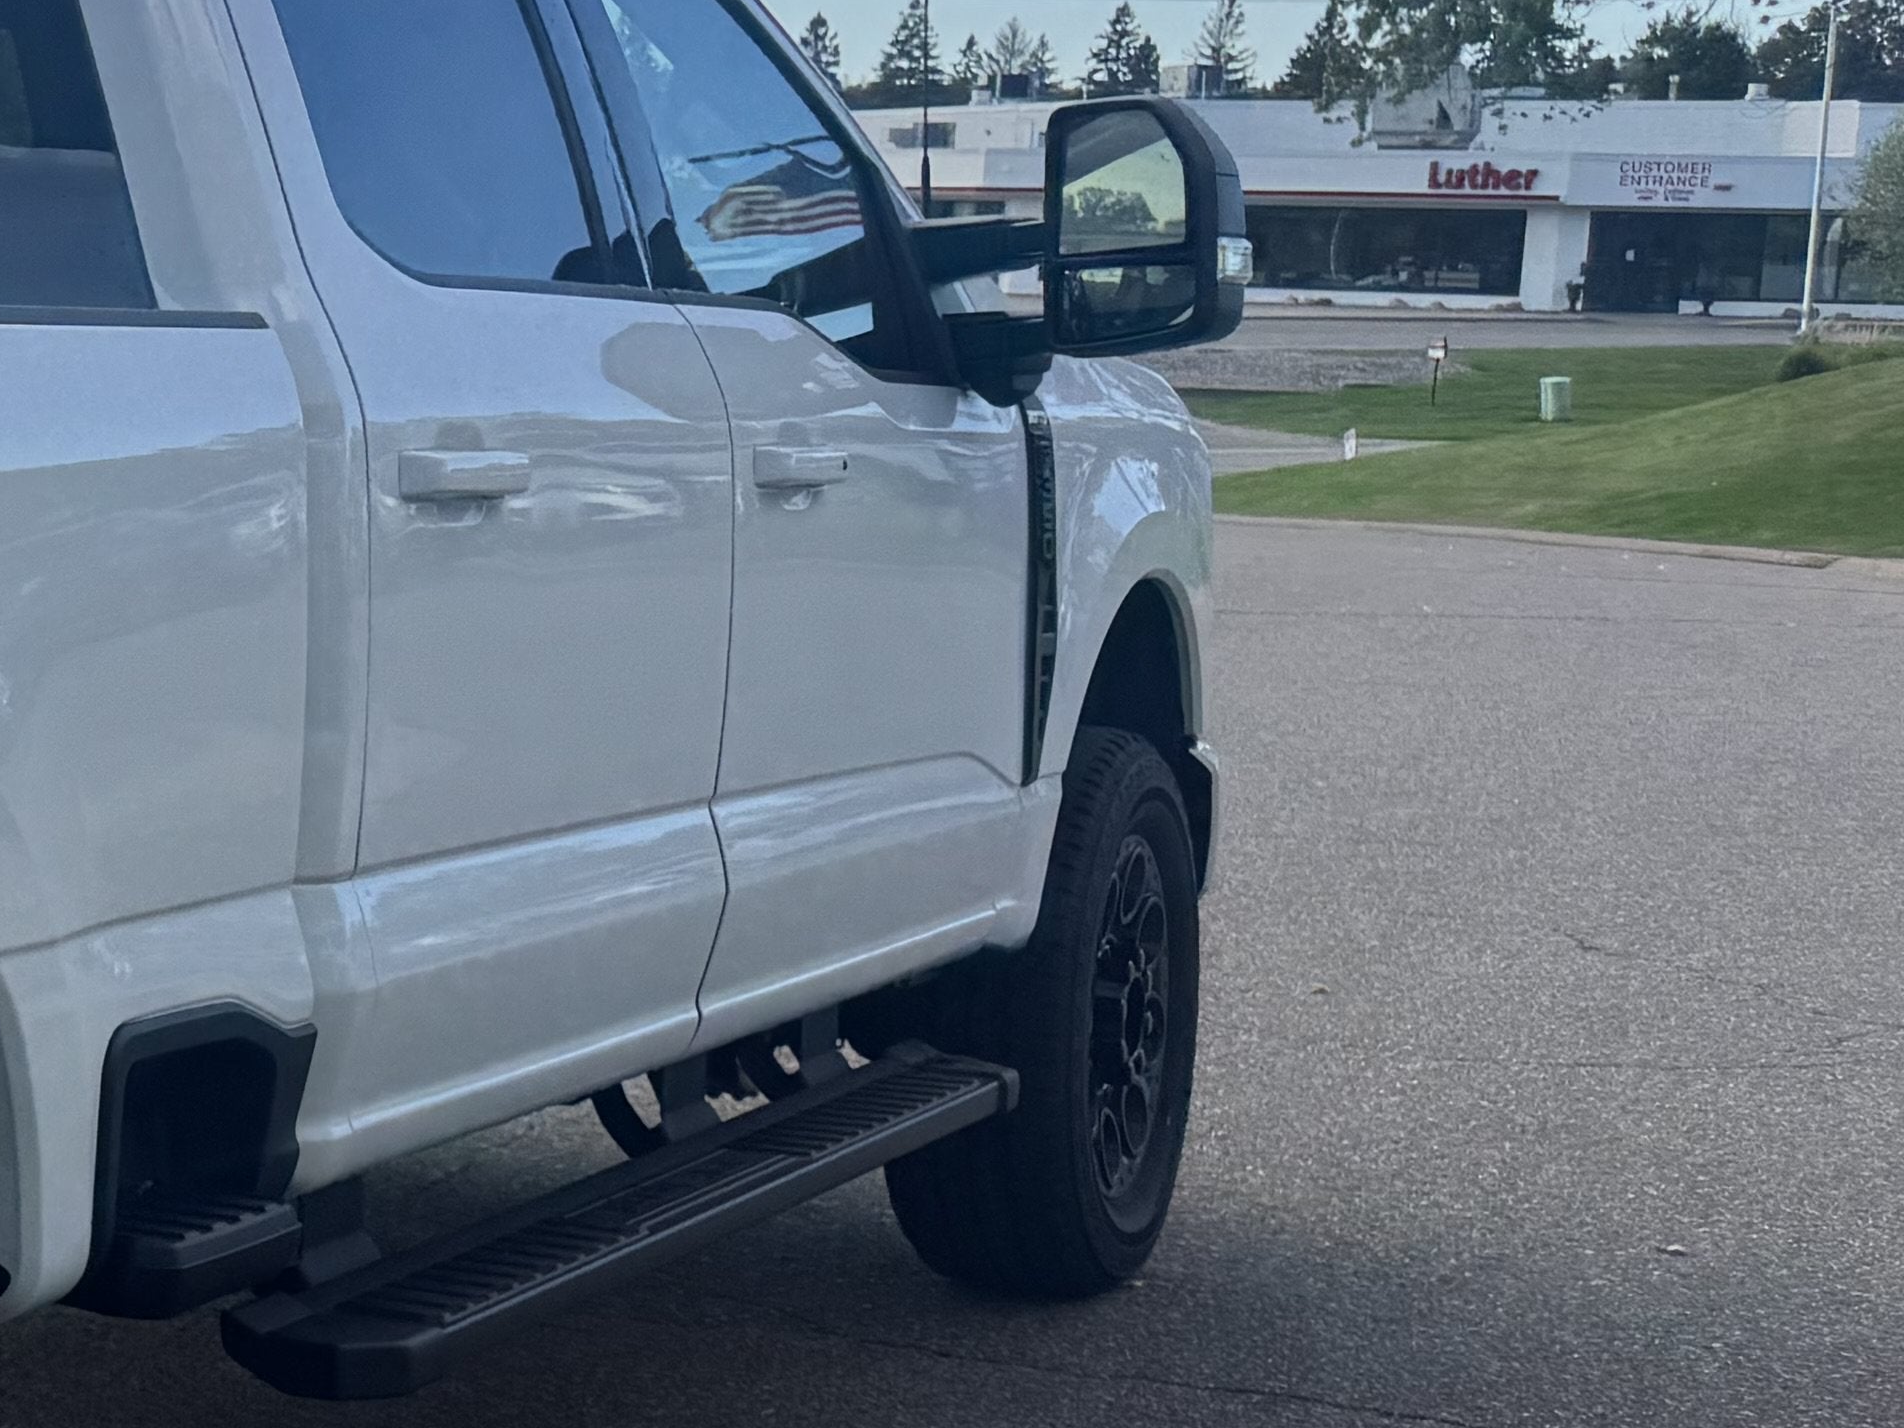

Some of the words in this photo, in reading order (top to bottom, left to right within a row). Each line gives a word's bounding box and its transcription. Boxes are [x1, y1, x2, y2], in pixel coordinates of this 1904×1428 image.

[1619, 160, 1713, 175] CUSTOMER
[1428, 160, 1540, 191] Luther
[1618, 174, 1711, 188] ENTRANCE
